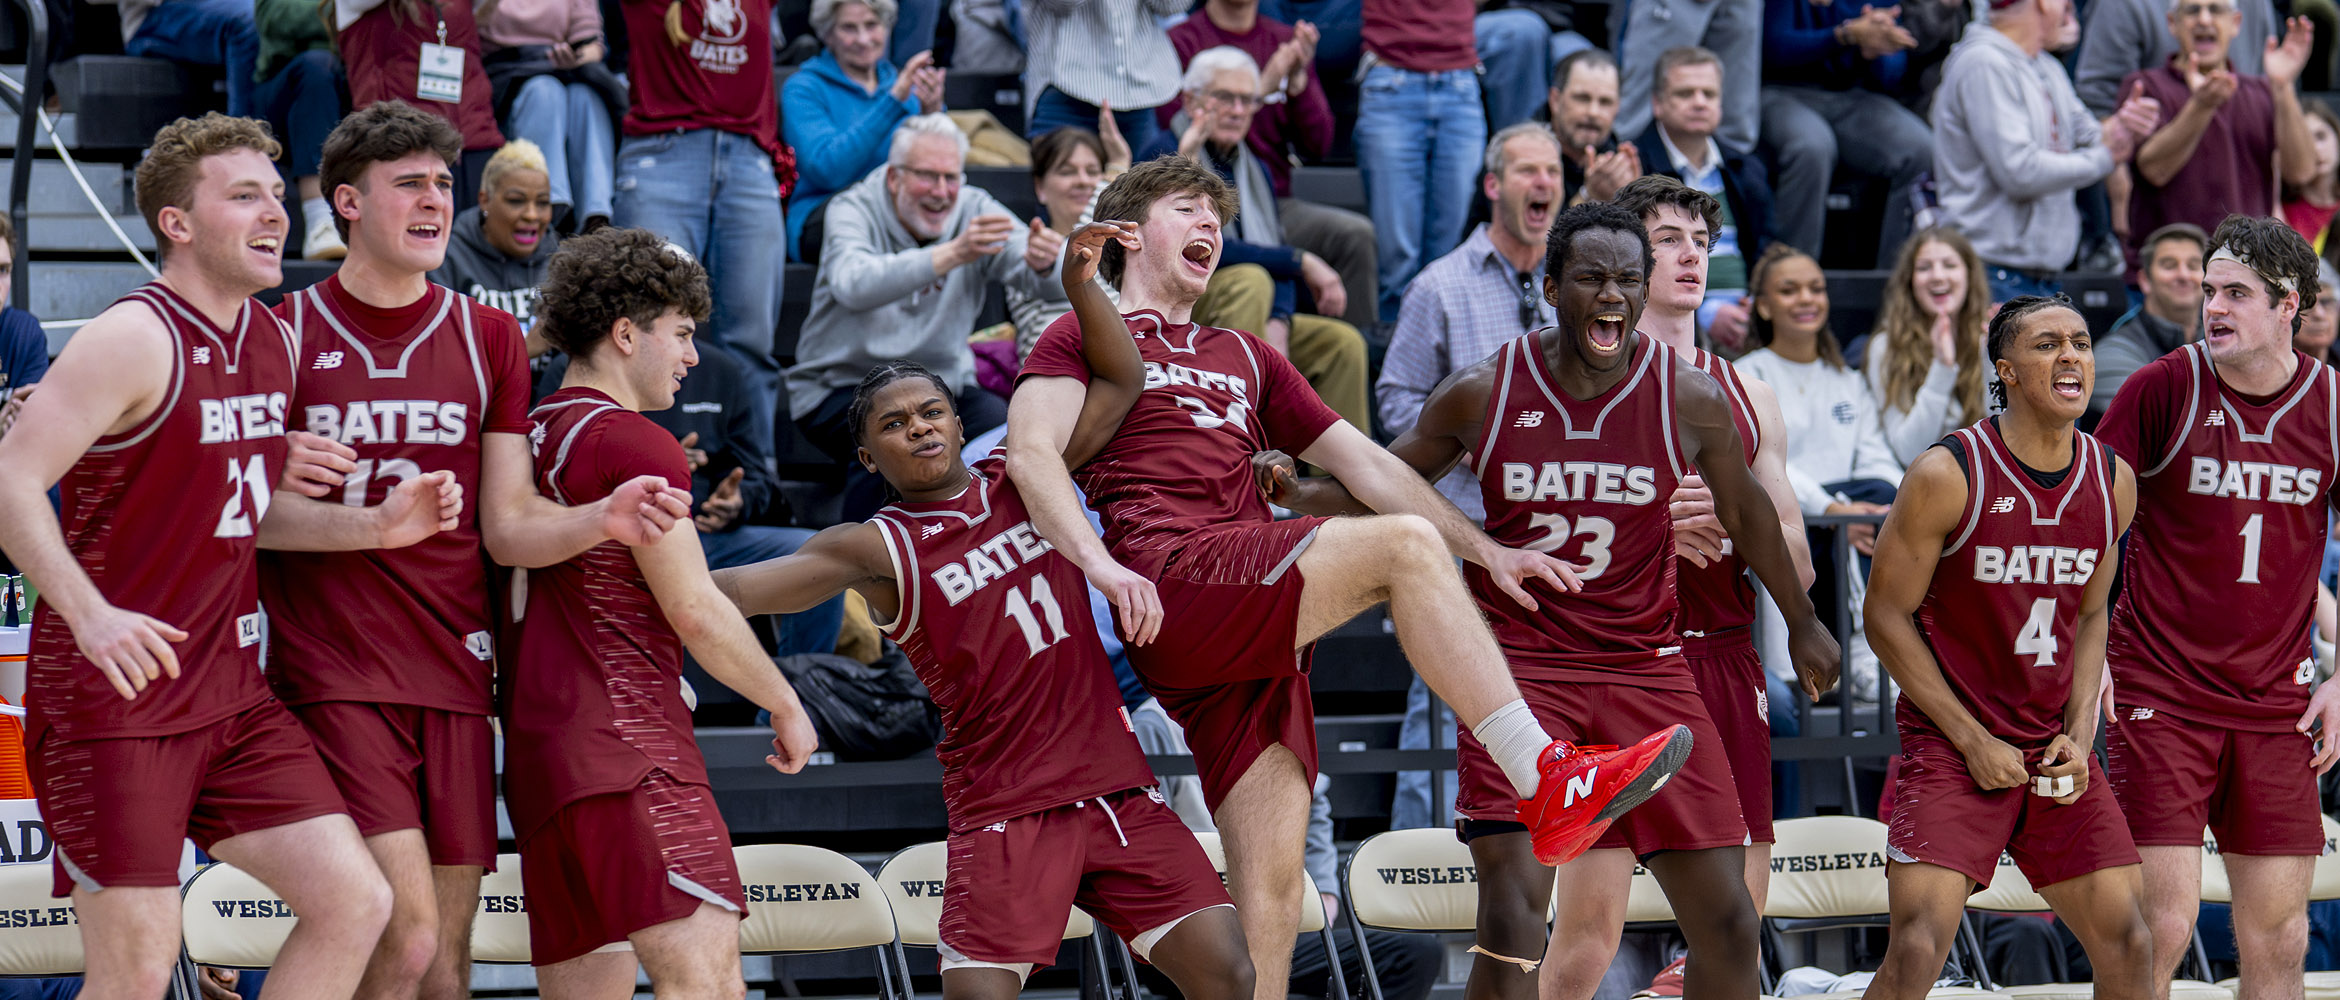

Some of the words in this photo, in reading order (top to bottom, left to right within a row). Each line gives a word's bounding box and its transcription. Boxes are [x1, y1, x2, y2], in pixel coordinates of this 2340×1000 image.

[199, 392, 287, 444] BATES
[305, 400, 467, 446] BATES
[213, 454, 271, 538] 21
[1502, 461, 1657, 506] BATES
[2187, 456, 2322, 506] BATES
[1518, 511, 1616, 581] 23
[1973, 545, 2098, 585] BATES
[2236, 513, 2263, 584] 1
[1005, 572, 1071, 659] 11
[2014, 597, 2058, 667] 4
[1770, 852, 1886, 872] WESLEYA
[212, 900, 296, 918] WESL
